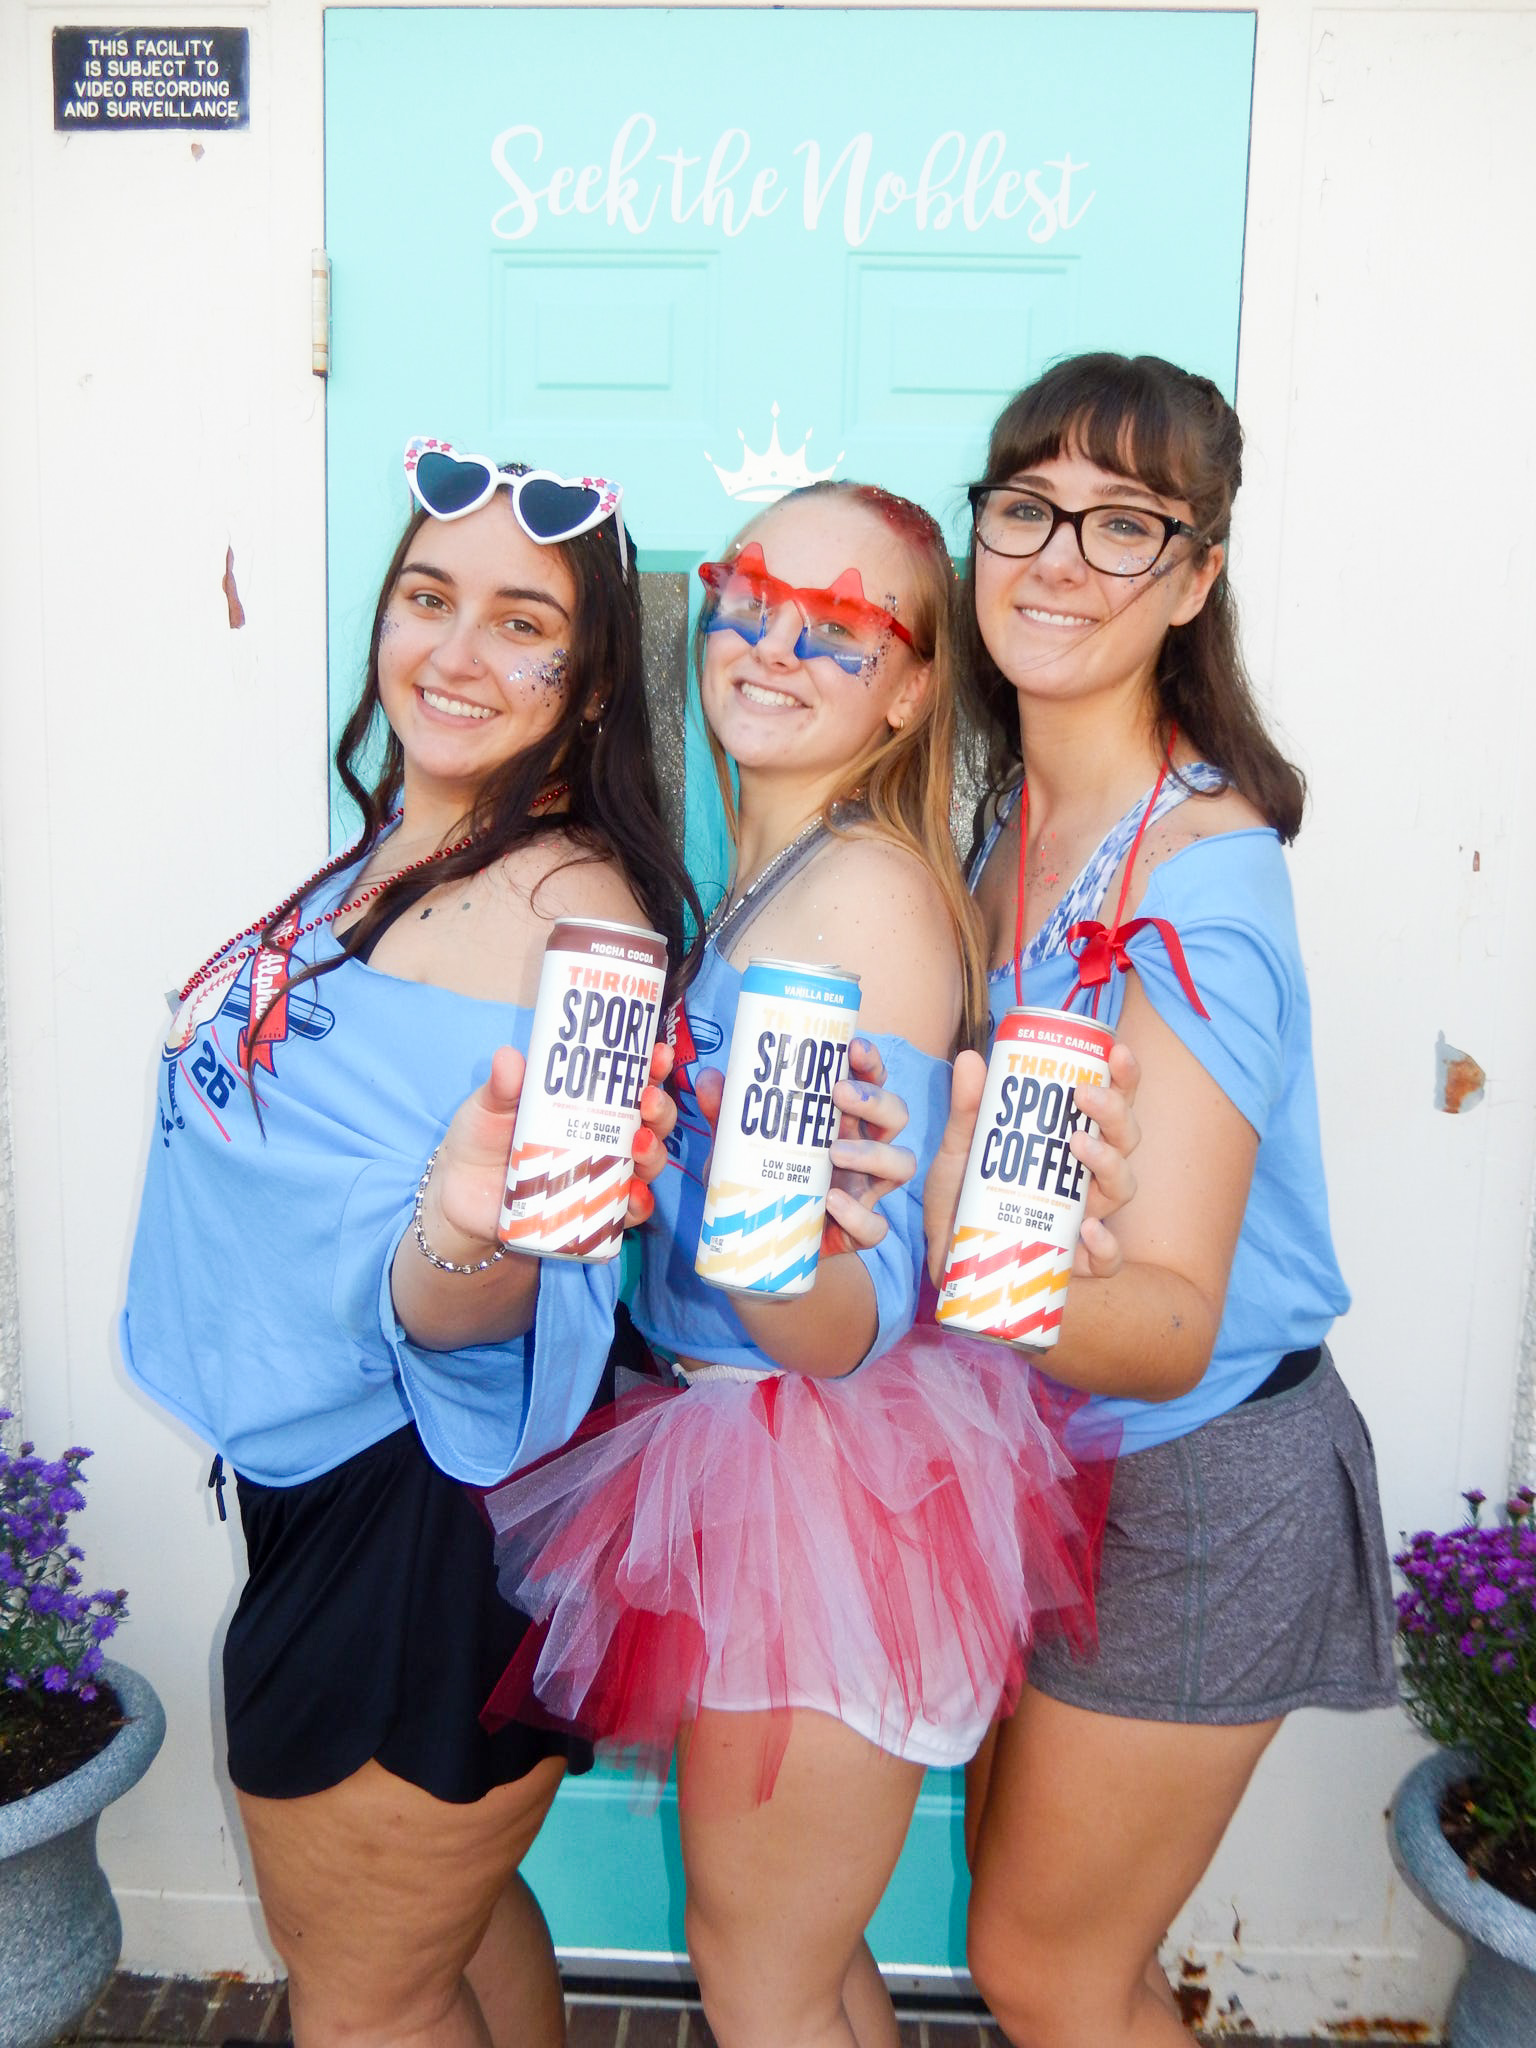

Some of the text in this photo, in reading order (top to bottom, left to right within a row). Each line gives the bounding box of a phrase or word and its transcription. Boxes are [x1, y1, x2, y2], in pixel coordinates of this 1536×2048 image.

[88, 40, 213, 56] THIS FACILITY
[85, 61, 219, 77] IS SUBJECT TO
[75, 81, 229, 97] VIDEO RECORDING
[64, 102, 239, 117] AND SURVEILLANCE
[490, 112, 1096, 246] Seek the Noblest
[591, 942, 654, 964] MOCHA COCOA
[568, 965, 660, 1003] THRONE
[784, 985, 845, 1004] VANILLA BEAN
[558, 988, 656, 1056] SPORT
[1017, 1028, 1105, 1057] SEA SALT CARAMEL
[753, 1030, 848, 1095] SPORT
[1008, 1053, 1103, 1088] THRONE
[190, 1040, 237, 1109] 26
[544, 1041, 649, 1111] COFFEE
[740, 1083, 836, 1149] COFFEE
[592, 1122, 622, 1135] SUGAR
[594, 1133, 620, 1145] BREW
[763, 1159, 812, 1175] LOW SUGAR
[980, 1127, 1085, 1202] COFFEE
[761, 1169, 810, 1185] COLD BREW
[997, 1212, 1053, 1233] COLD BREW
[999, 1202, 1055, 1223] LOW SUGAR
